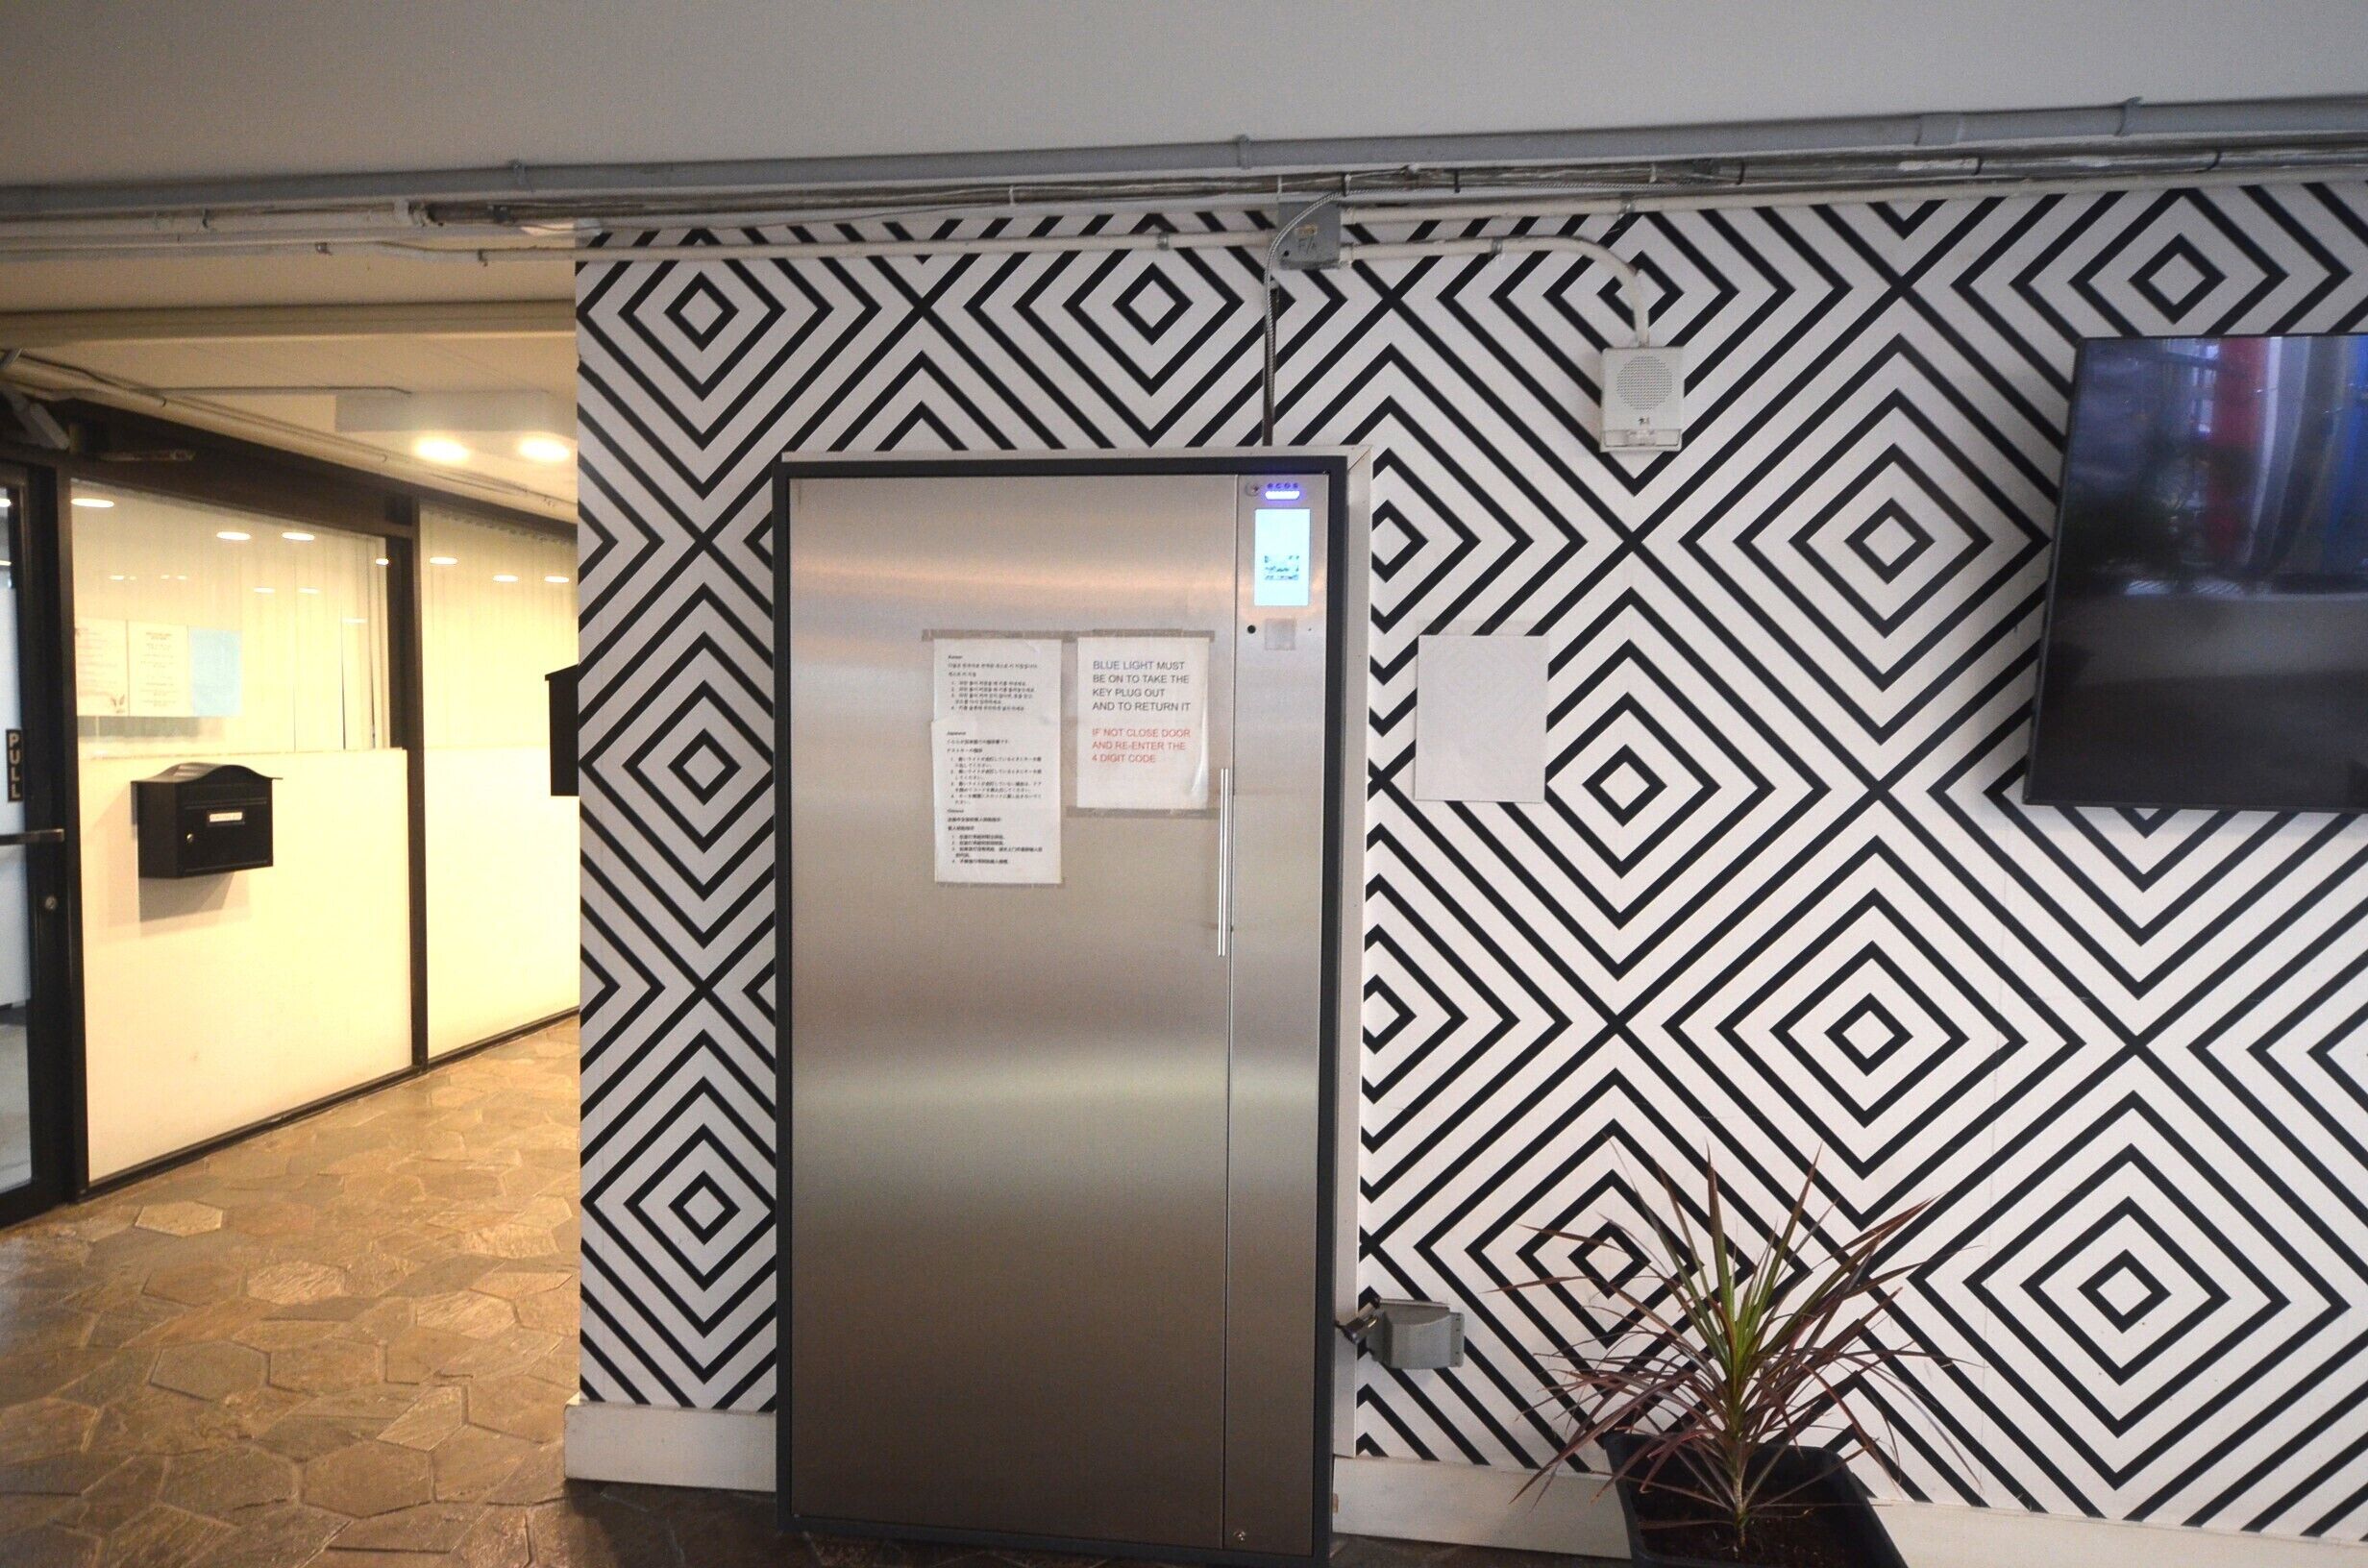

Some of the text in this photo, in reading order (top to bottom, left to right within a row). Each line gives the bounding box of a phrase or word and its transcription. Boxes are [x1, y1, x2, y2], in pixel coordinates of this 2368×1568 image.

[1093, 660, 1185, 671] BLUE LIGHT MUST
[1093, 674, 1190, 684] BE ON TO TAKE THE
[1092, 688, 1165, 698] KEY PLUG OUT
[1092, 701, 1191, 711] AND TO RETURN IT
[1092, 728, 1191, 738] IF NOT CLOSE DOOR
[1092, 741, 1185, 750] AND RE-ENTER THE
[1091, 753, 1156, 763] 4 DIGIT CODE
[9, 732, 21, 798] PULL
